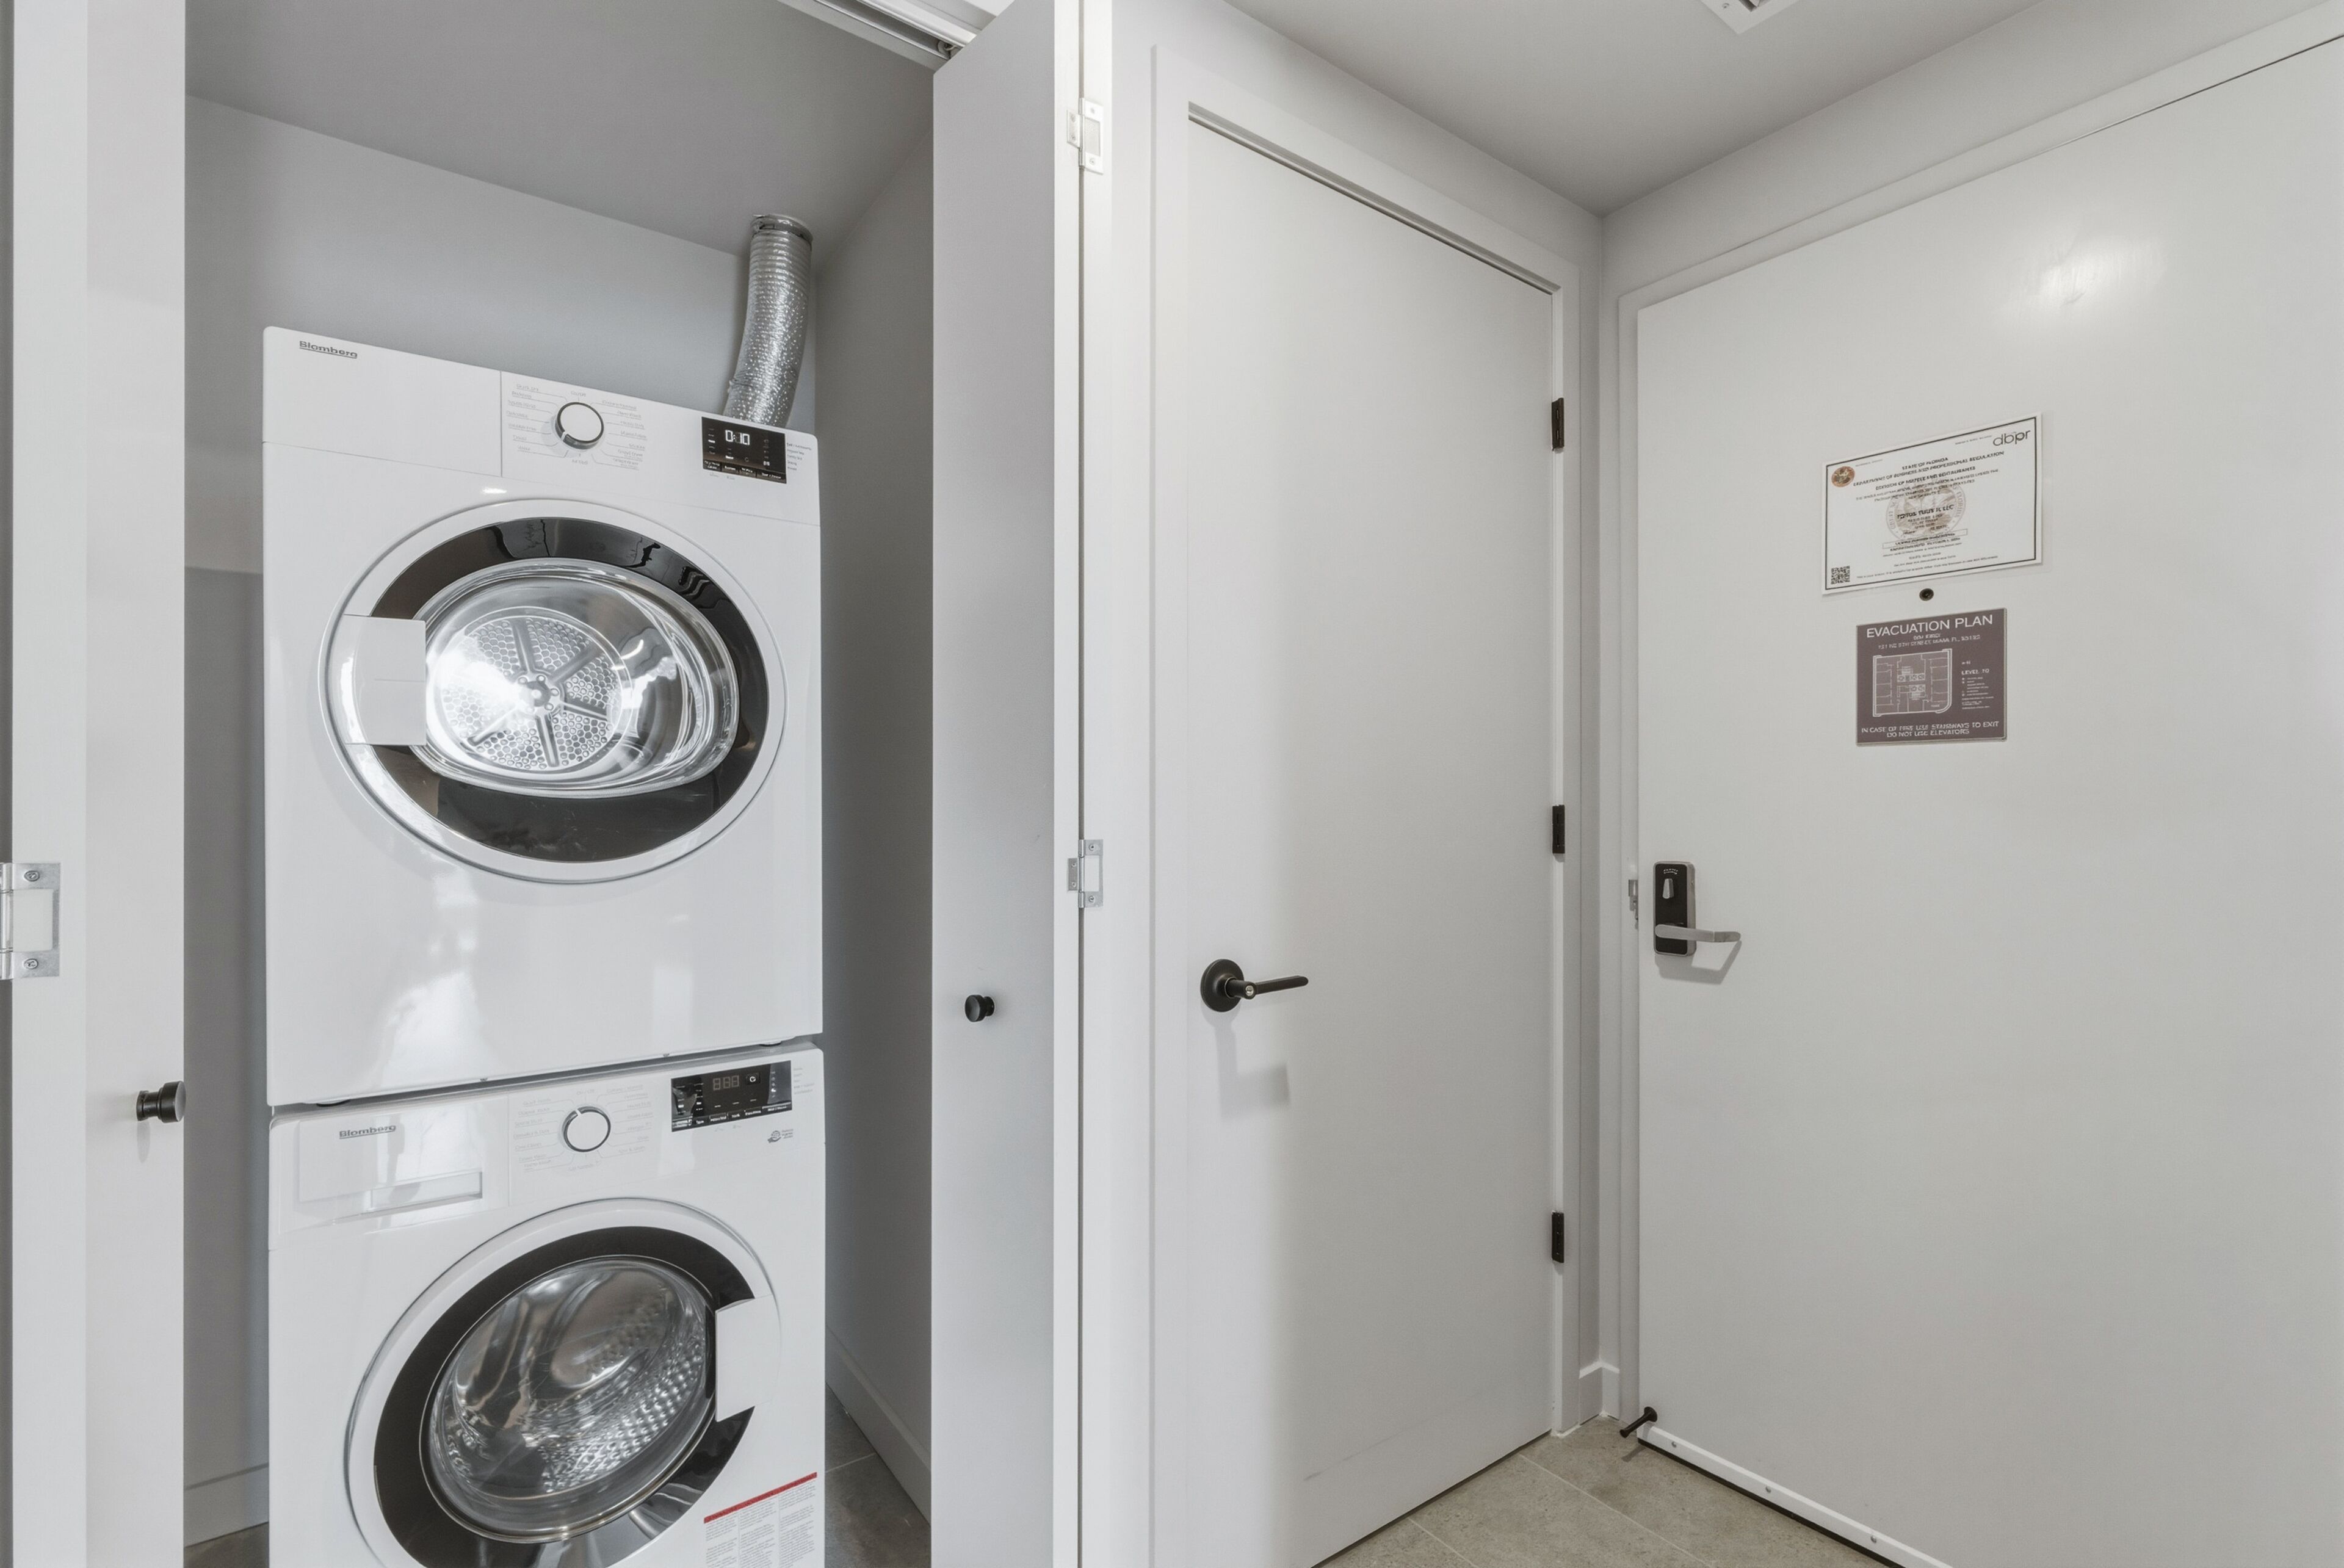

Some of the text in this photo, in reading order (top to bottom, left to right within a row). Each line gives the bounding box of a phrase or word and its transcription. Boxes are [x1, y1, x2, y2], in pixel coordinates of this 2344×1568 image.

[299, 341, 357, 359] Blomberg
[725, 429, 750, 446] 0:10
[1992, 430, 2031, 446] dbpr
[1867, 614, 1993, 638] EVACUATION PLAN
[339, 1125, 396, 1140] Blomberg
